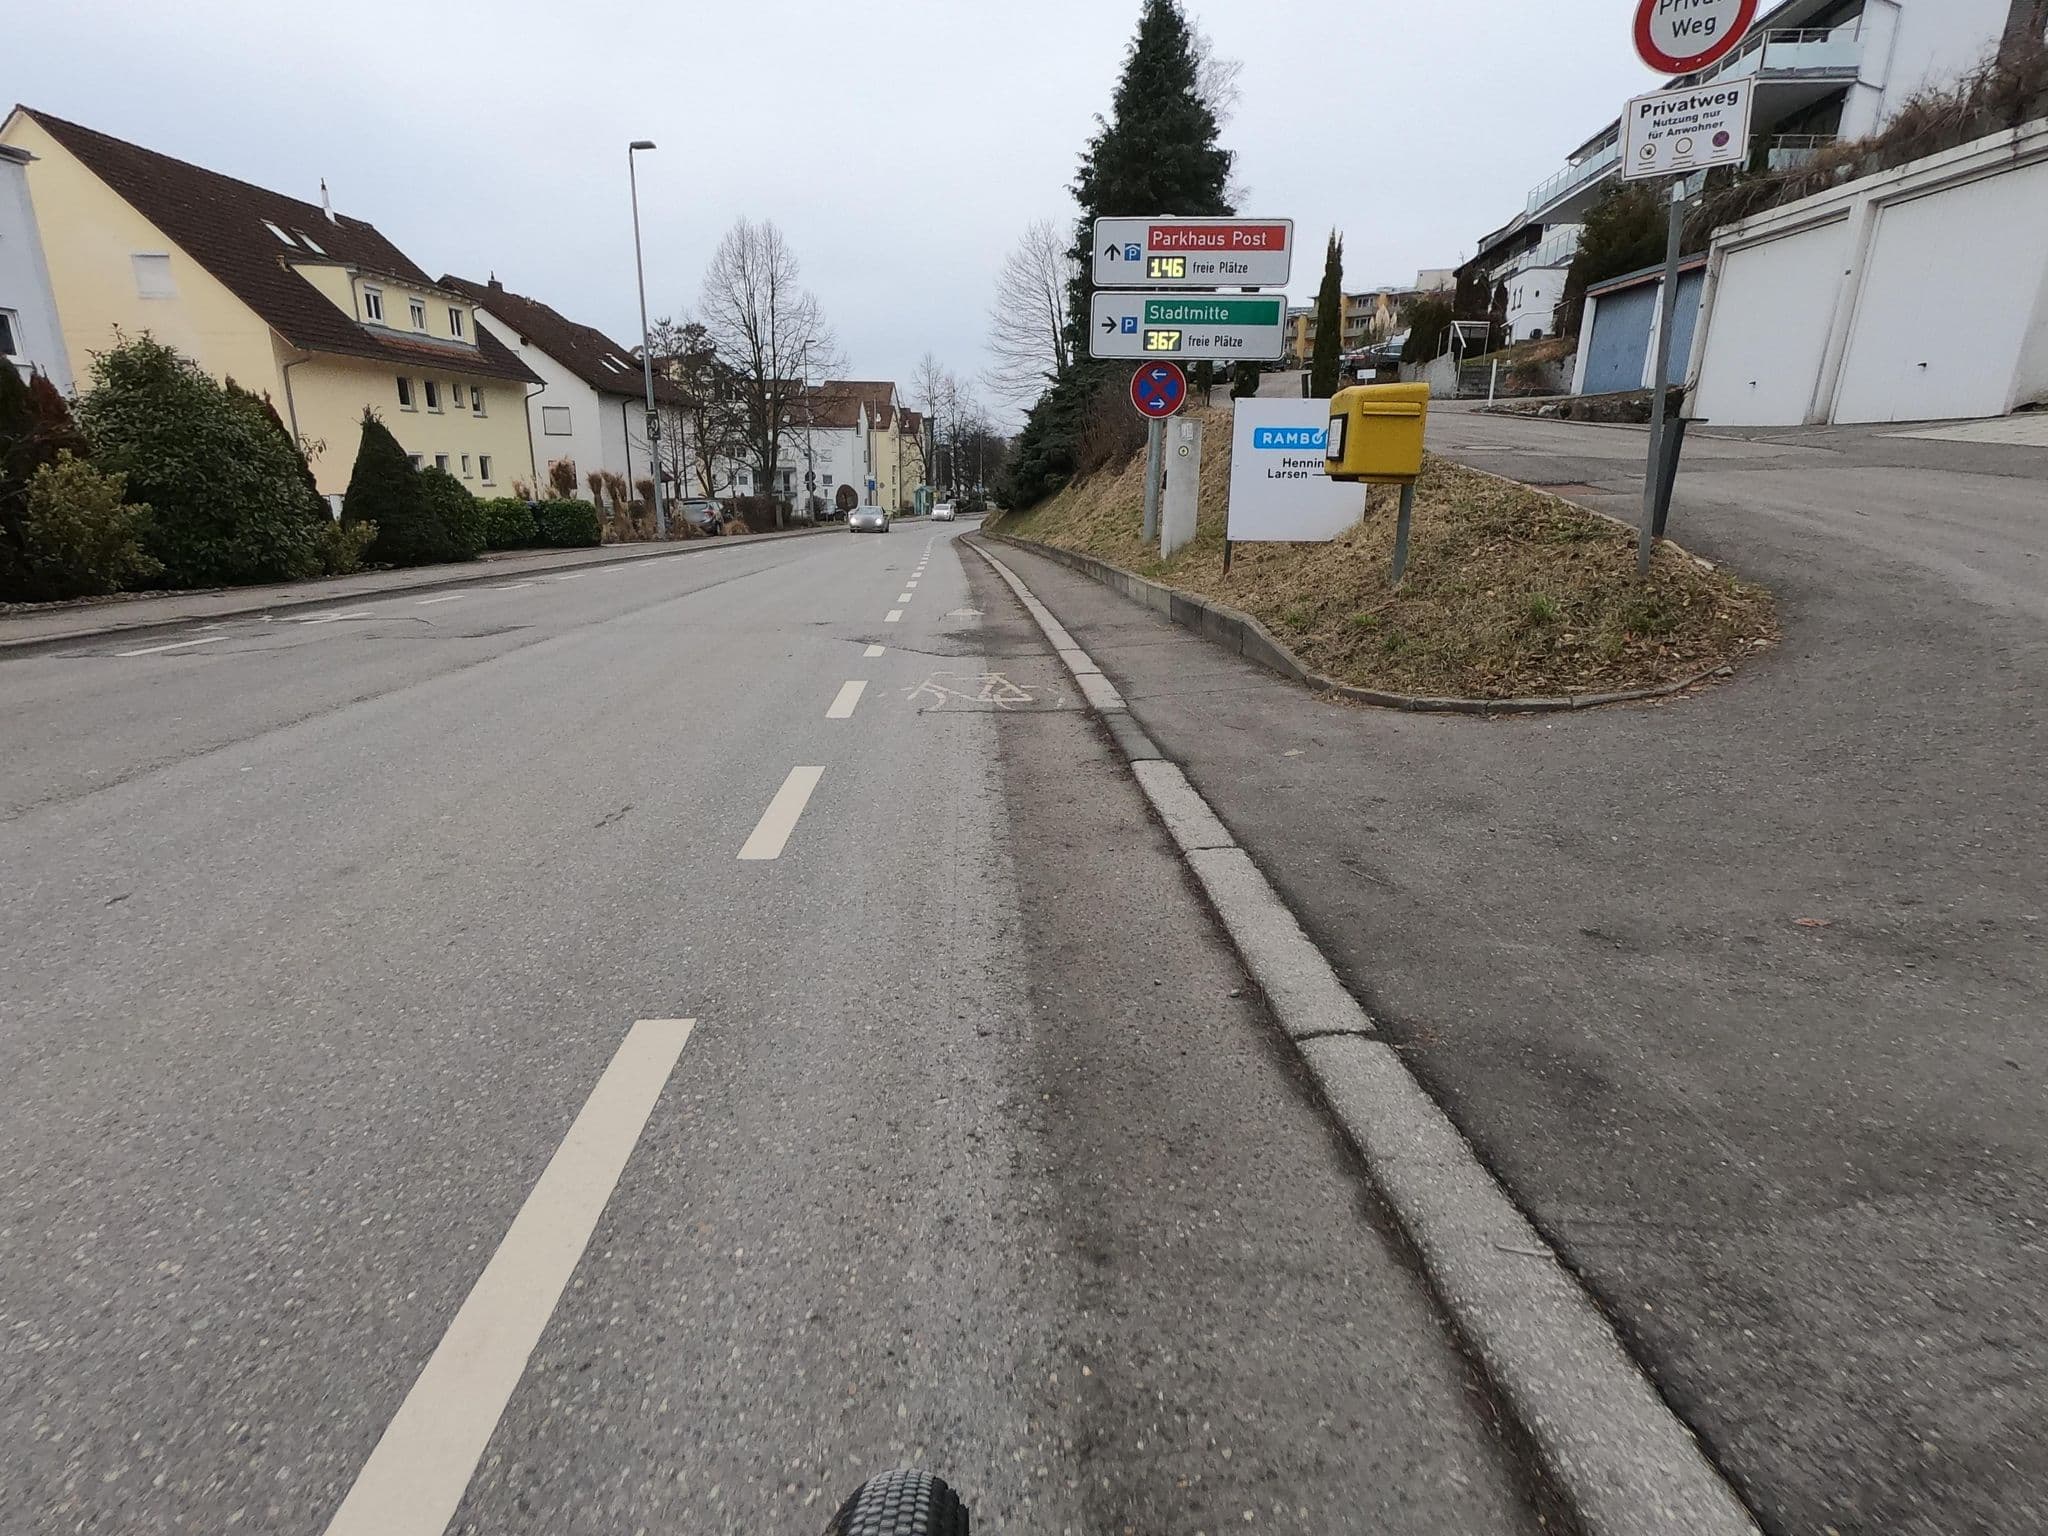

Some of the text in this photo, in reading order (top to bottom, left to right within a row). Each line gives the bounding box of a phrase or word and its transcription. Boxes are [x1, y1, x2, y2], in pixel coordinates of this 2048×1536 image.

[1672, 16, 1716, 38] Weg
[1640, 90, 1739, 119] Privatweg
[1652, 109, 1721, 128] Nutzung nur
[1648, 121, 1724, 140] für Anwohner
[1152, 230, 1267, 246] Parkhaus Post
[1150, 258, 1184, 278] 146
[1192, 261, 1248, 274] freie Plätze
[1150, 305, 1229, 320] Stadtmitte
[1147, 331, 1180, 350] 367
[1188, 334, 1243, 347] freie Plätze
[1282, 457, 1325, 468] Hennin
[1267, 468, 1308, 479] Larsen
